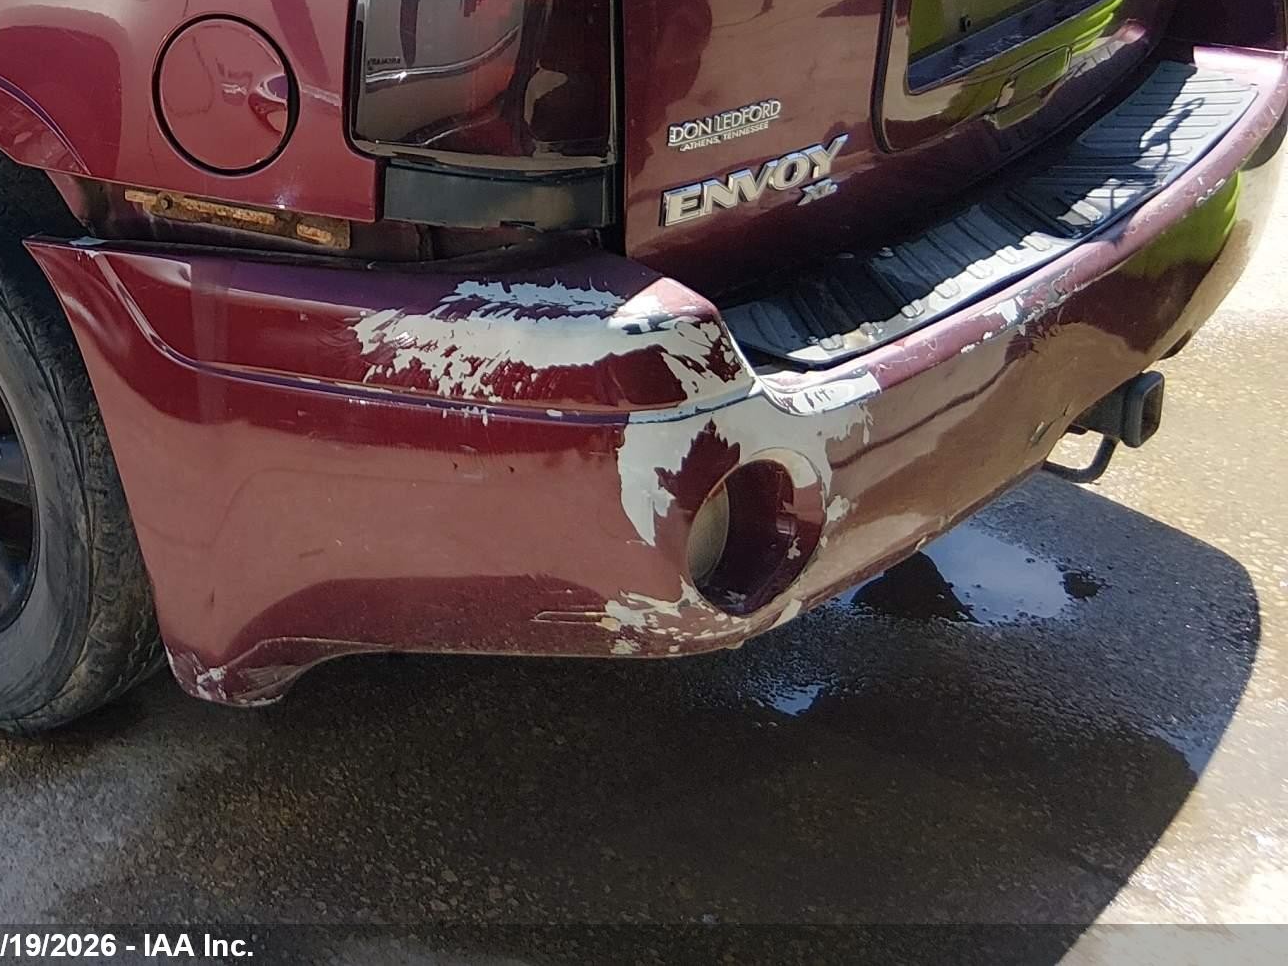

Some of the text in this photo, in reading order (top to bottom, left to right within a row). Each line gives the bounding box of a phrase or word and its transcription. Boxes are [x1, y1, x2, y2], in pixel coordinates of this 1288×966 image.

[668, 100, 781, 144] DON LEDFORD
[722, 122, 769, 141] TENNESSEE
[663, 133, 849, 226] ENVOY
[797, 177, 838, 206] XL
